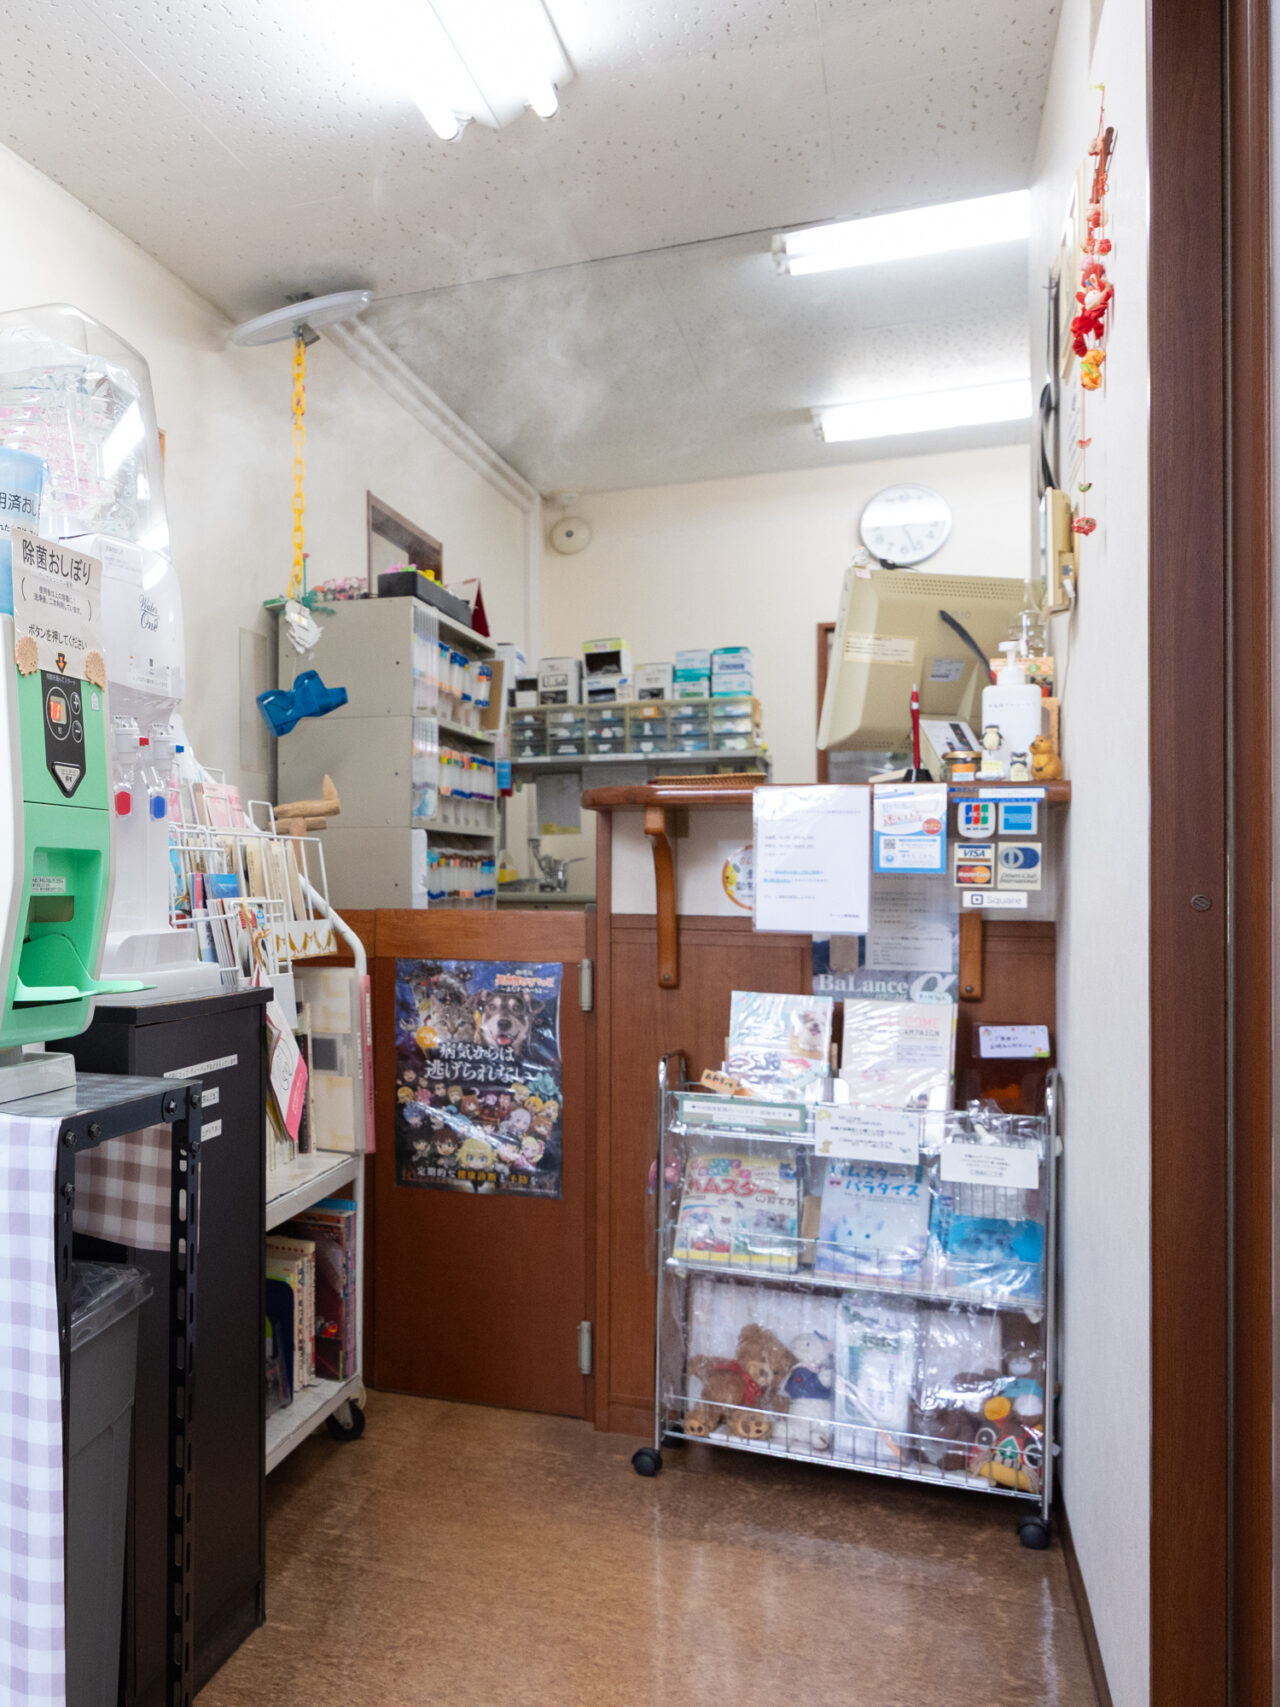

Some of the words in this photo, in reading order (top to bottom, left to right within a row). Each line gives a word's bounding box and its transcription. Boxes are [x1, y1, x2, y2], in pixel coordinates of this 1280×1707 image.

[22, 538, 91, 586] 除菌おしぼり
[28, 623, 88, 651] ボタンを押してください
[963, 849, 986, 857] VISA
[986, 896, 1022, 906] Square
[819, 974, 909, 994] BaLance
[439, 1040, 515, 1063] 病気からは
[423, 1058, 533, 1084] 逃げられない
[686, 1177, 777, 1198] ハムスター
[844, 1179, 920, 1199] パラダイス
